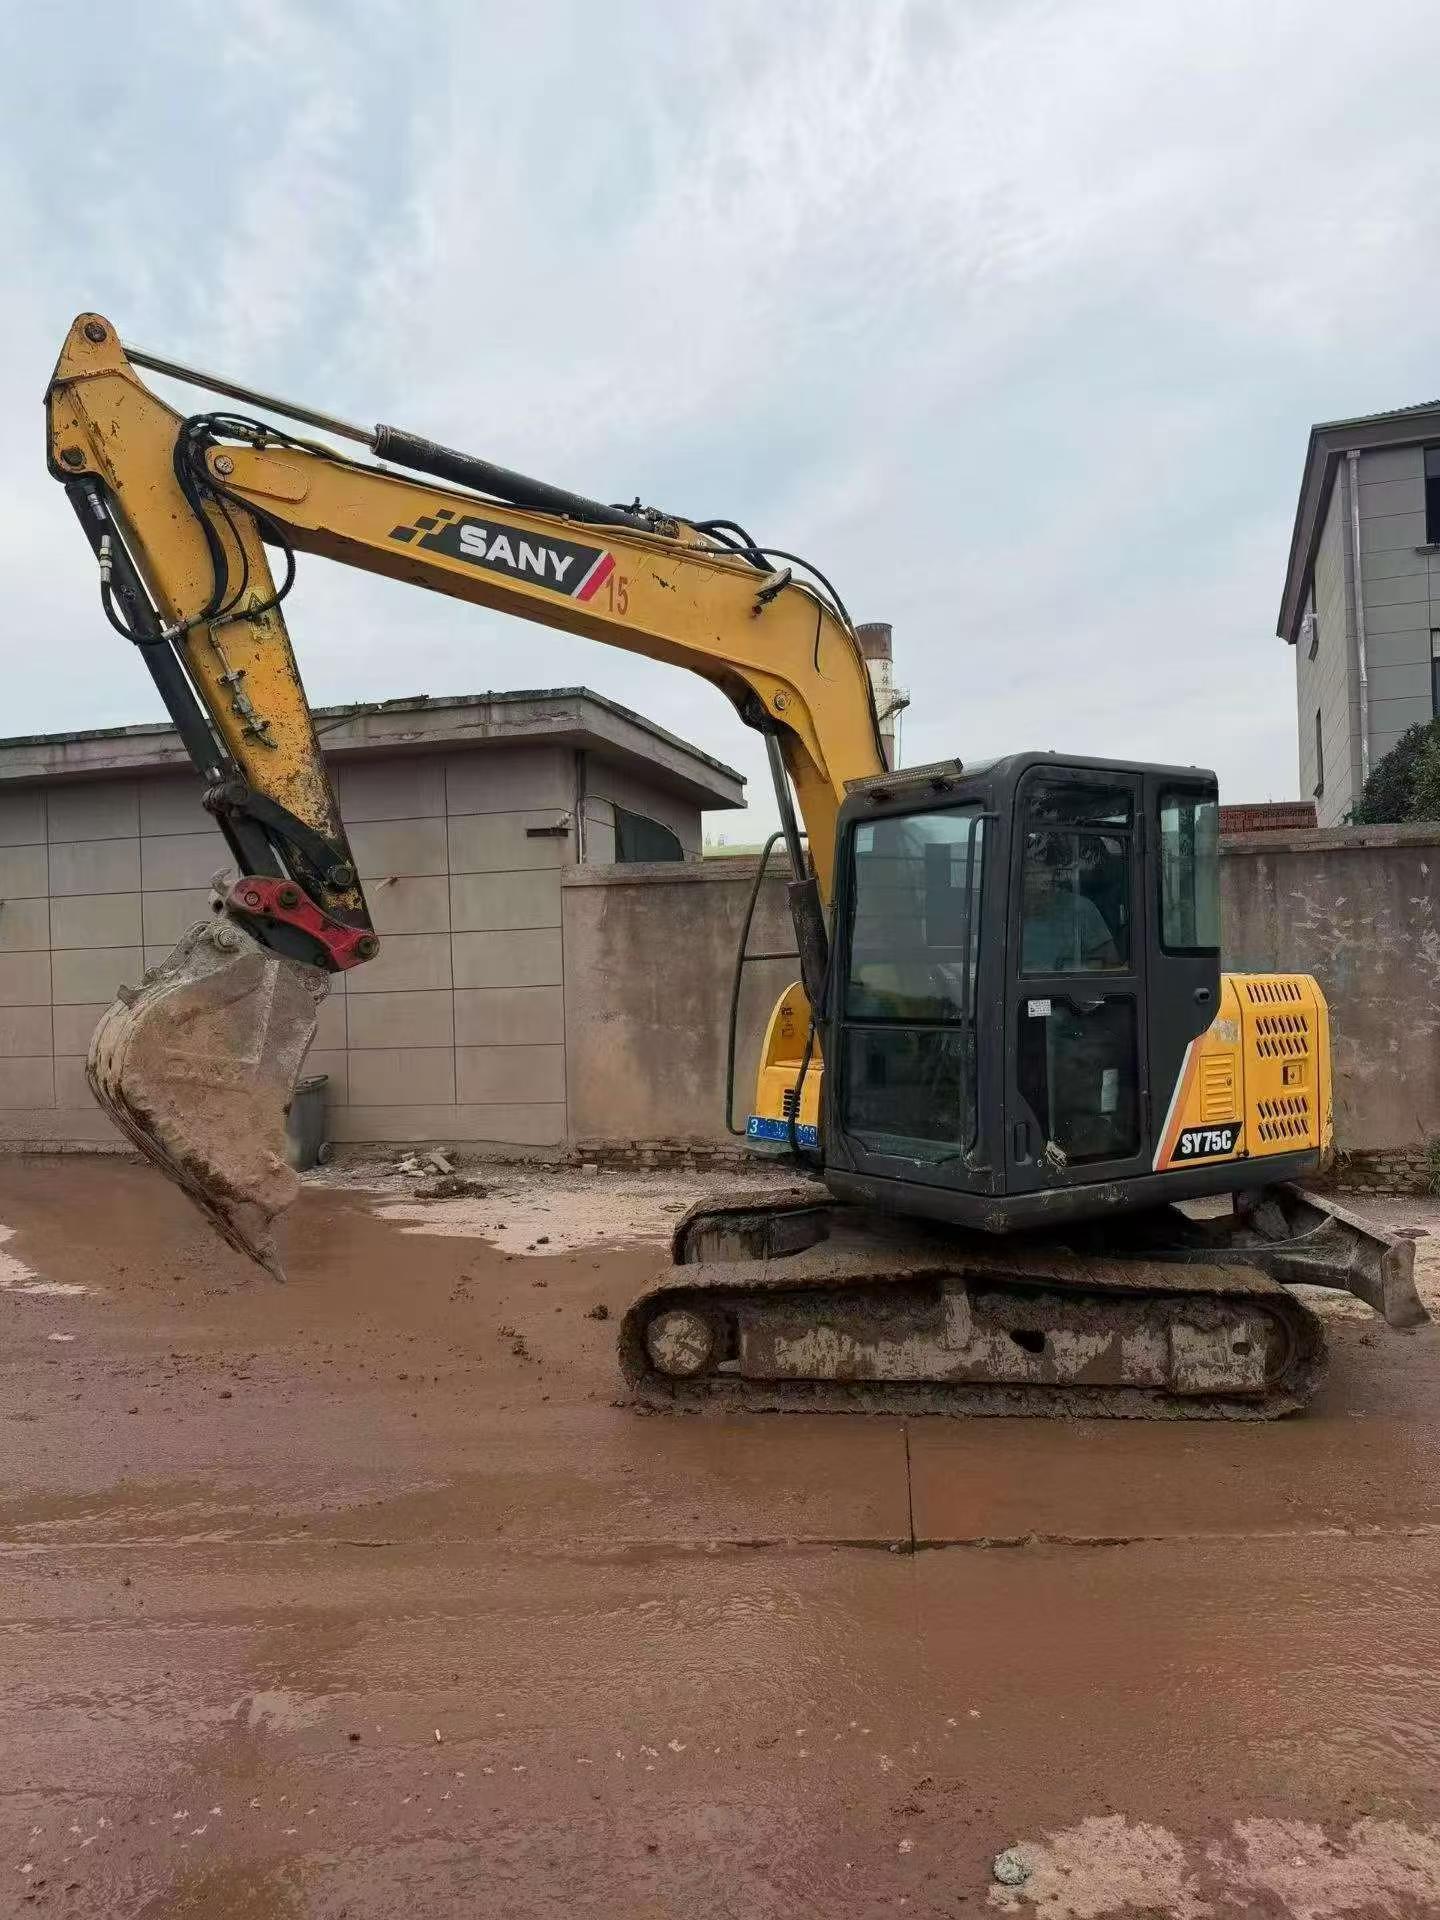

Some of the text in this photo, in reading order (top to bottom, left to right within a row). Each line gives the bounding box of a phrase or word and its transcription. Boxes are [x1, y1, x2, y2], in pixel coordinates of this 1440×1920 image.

[460, 524, 575, 582] SANY
[605, 572, 629, 615] 15
[1181, 1129, 1232, 1154] SY75C
